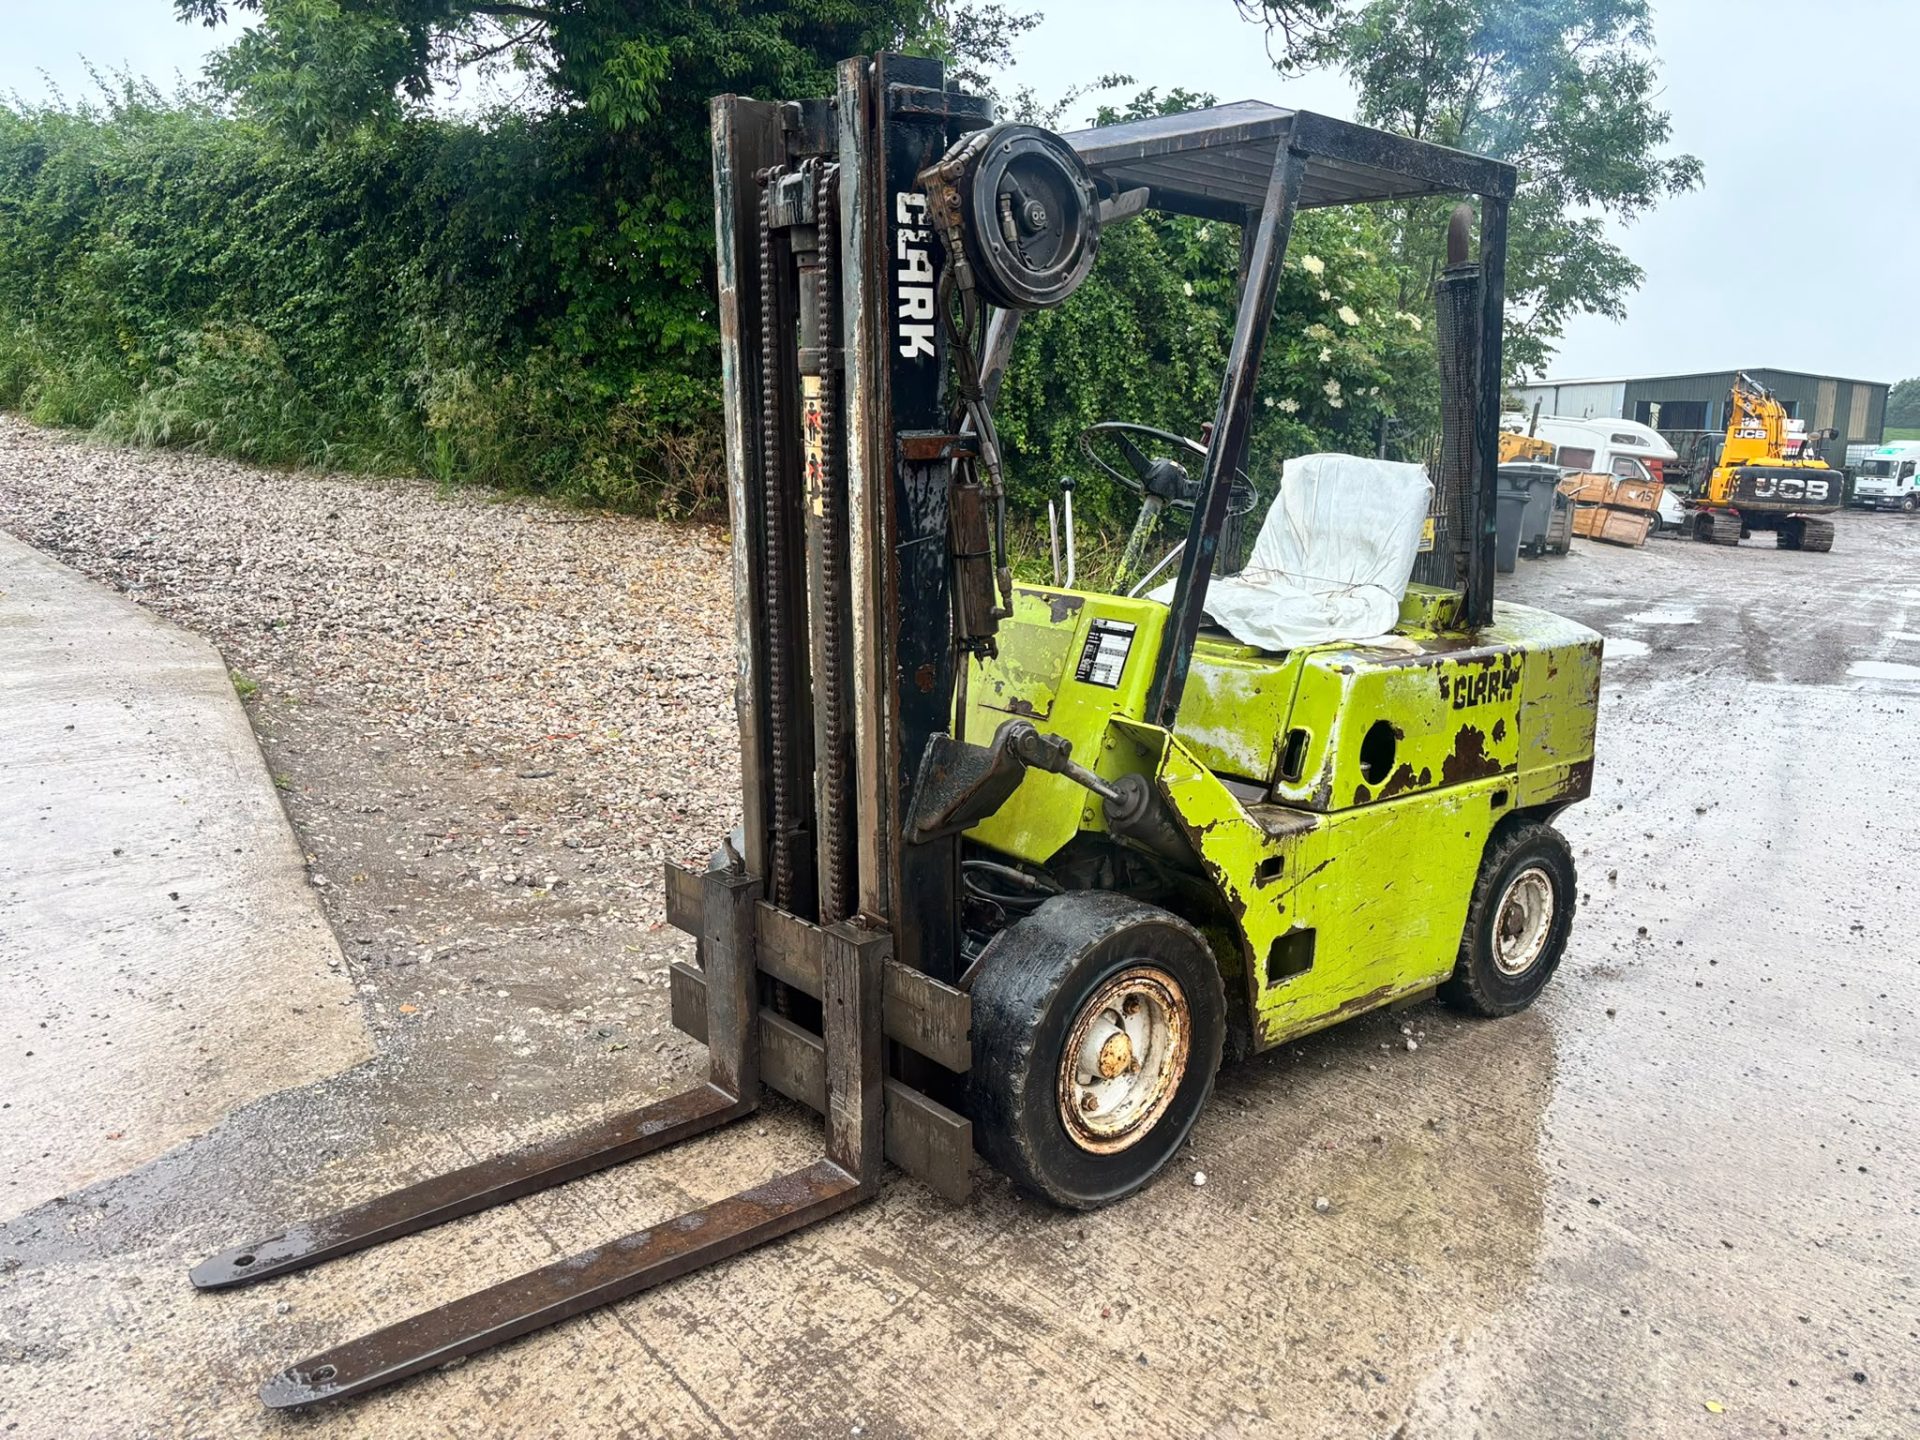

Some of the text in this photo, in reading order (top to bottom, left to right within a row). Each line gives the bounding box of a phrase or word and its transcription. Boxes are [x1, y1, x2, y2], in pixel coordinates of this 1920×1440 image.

[897, 192, 935, 358] CLARK
[1735, 429, 1767, 439] JCB
[1754, 478, 1829, 501] JCB
[1453, 667, 1519, 710] CLARK
